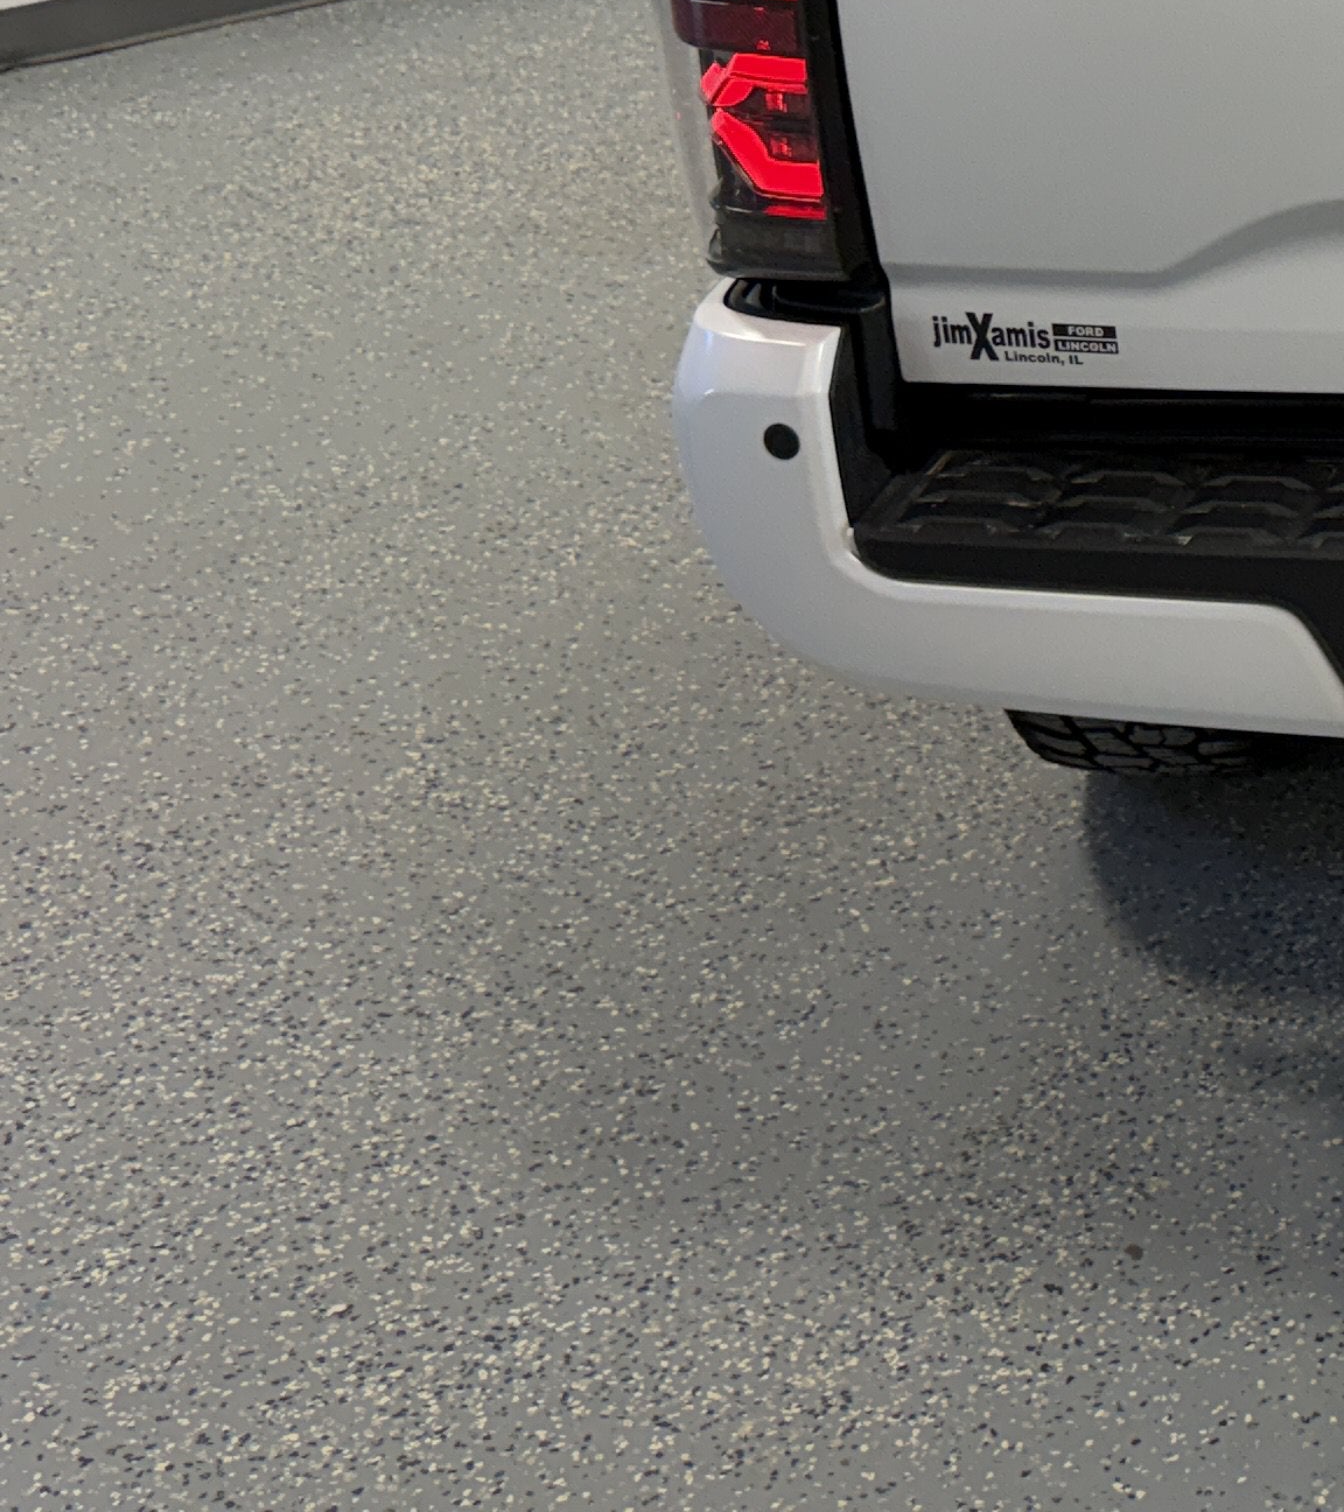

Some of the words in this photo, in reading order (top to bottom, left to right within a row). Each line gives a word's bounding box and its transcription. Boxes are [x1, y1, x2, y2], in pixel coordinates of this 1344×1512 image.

[1067, 325, 1105, 338] FORD
[1057, 341, 1118, 353] LINCOLN
[1004, 350, 1066, 367] Lincoln,
[1068, 354, 1085, 366] IL
